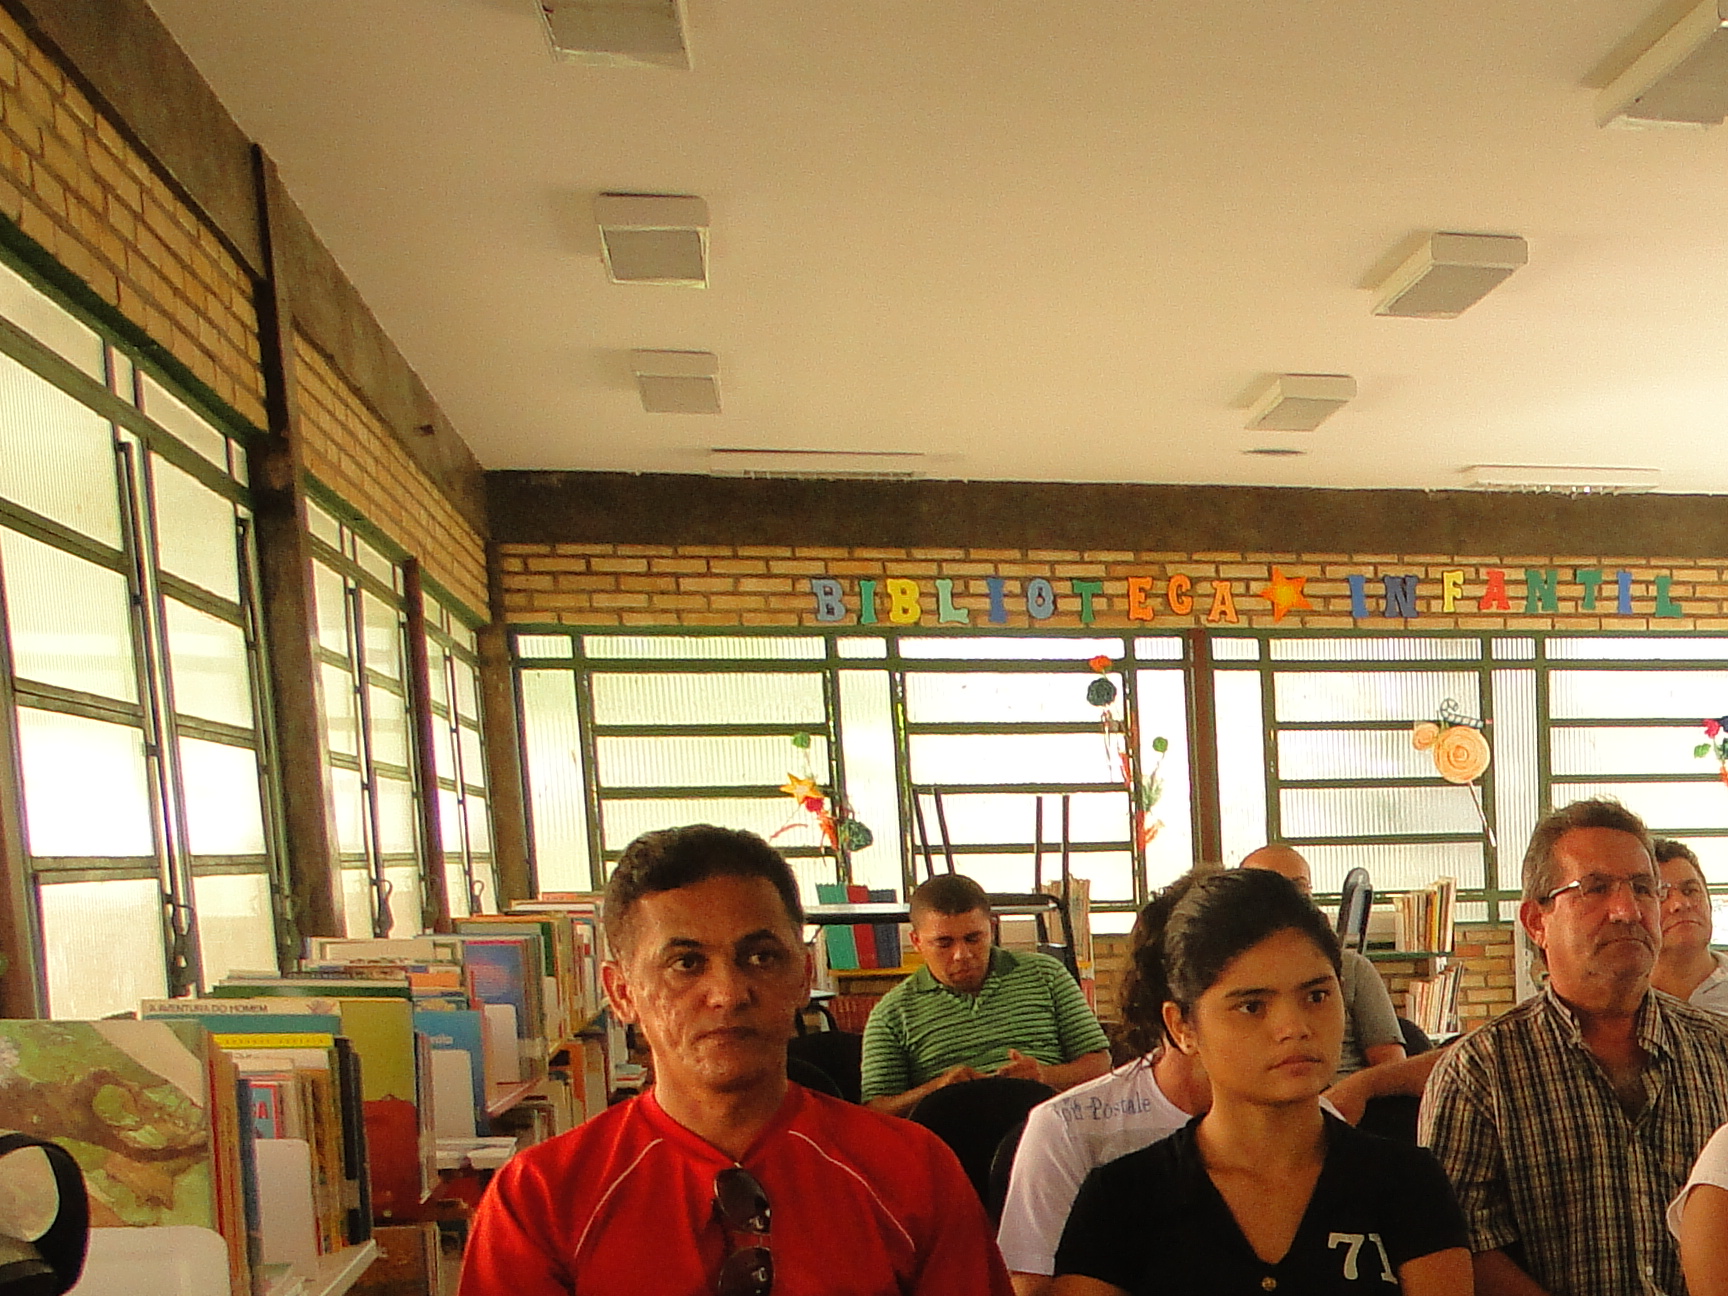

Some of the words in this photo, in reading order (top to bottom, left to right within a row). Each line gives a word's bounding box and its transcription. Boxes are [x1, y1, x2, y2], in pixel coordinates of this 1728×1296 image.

[811, 574, 1240, 624] BIBLIOTECA
[1347, 569, 1684, 618] INFANTIL
[230, 1004, 269, 1013] HOMEM
[1327, 1232, 1399, 1285] 71
